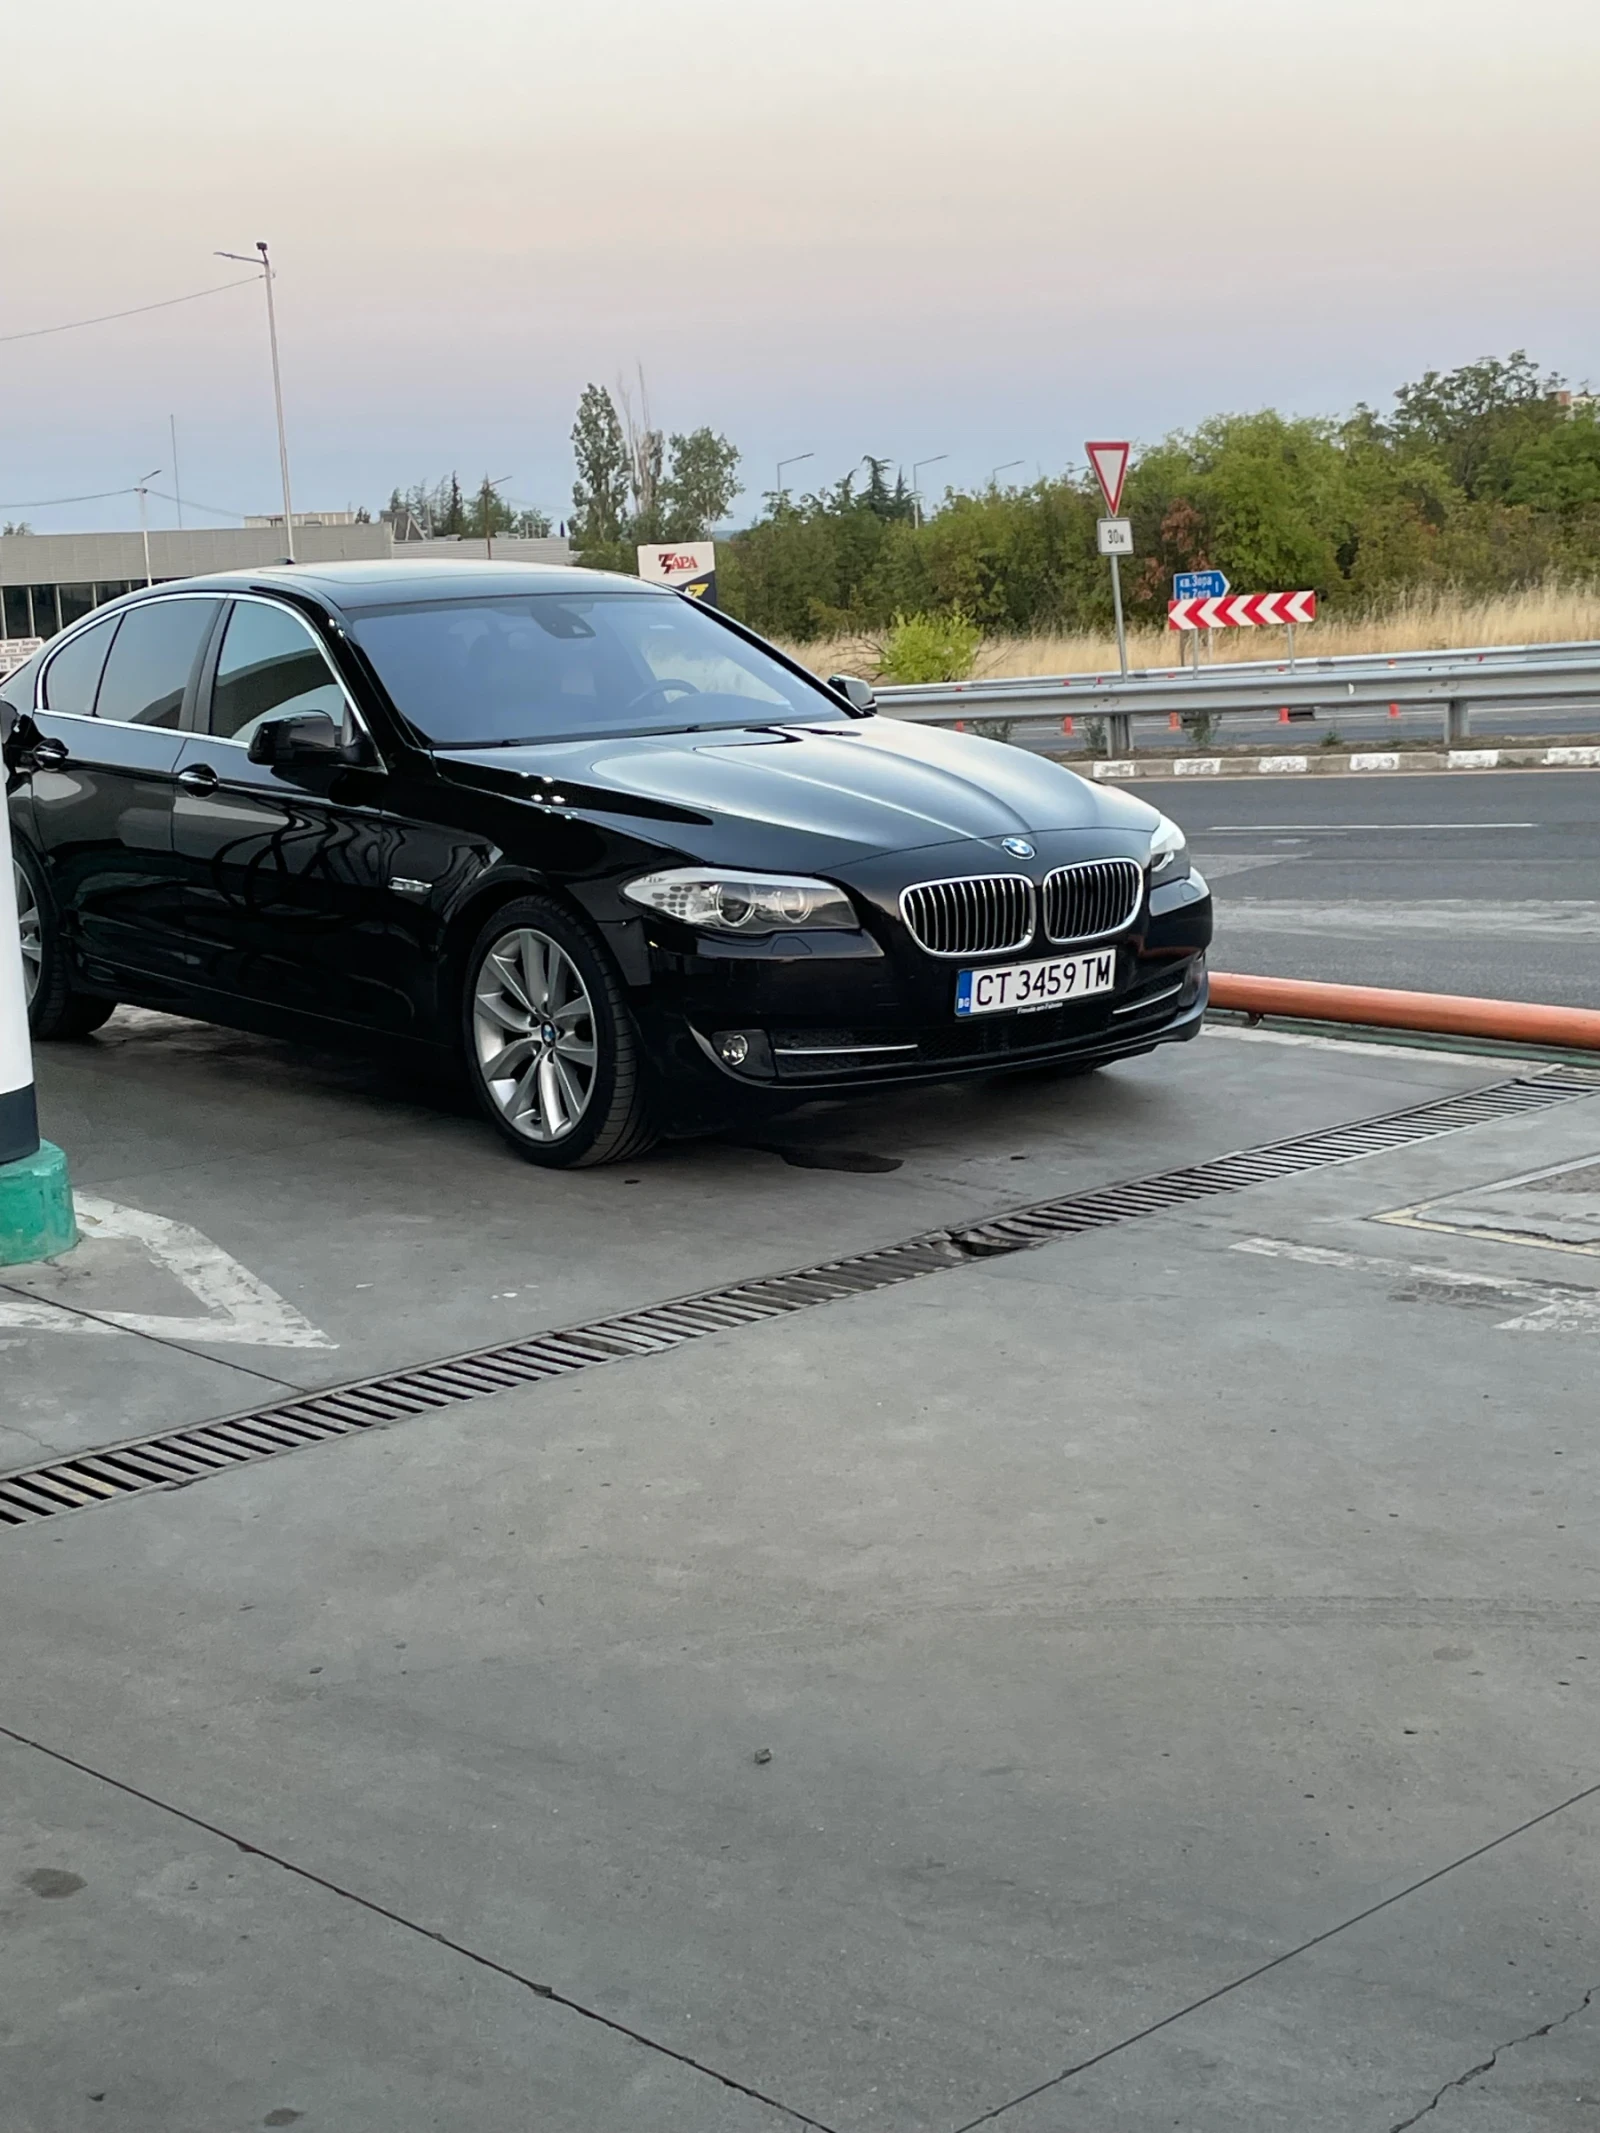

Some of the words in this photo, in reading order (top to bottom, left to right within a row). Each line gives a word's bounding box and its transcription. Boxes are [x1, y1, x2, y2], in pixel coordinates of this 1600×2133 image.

[976, 971, 1012, 1006] CT
[1016, 962, 1076, 1001] 3459
[1082, 954, 1111, 989] TM
